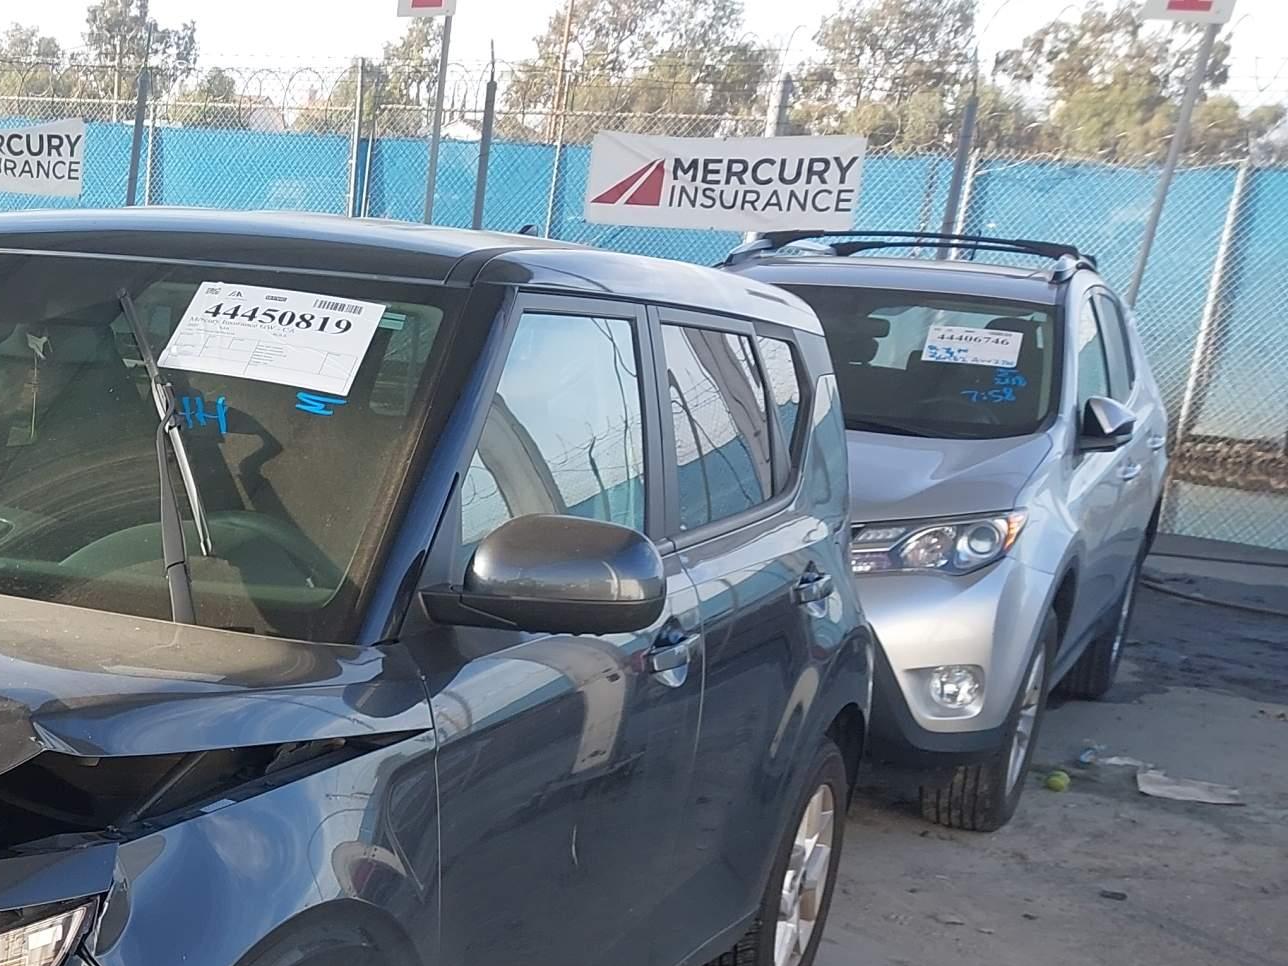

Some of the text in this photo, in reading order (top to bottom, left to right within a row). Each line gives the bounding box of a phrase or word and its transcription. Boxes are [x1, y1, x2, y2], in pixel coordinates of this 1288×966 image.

[672, 156, 859, 185] MERCURY
[668, 184, 855, 212] INSURANCE
[204, 302, 353, 335] 44450819
[937, 333, 1010, 345] 44406746
